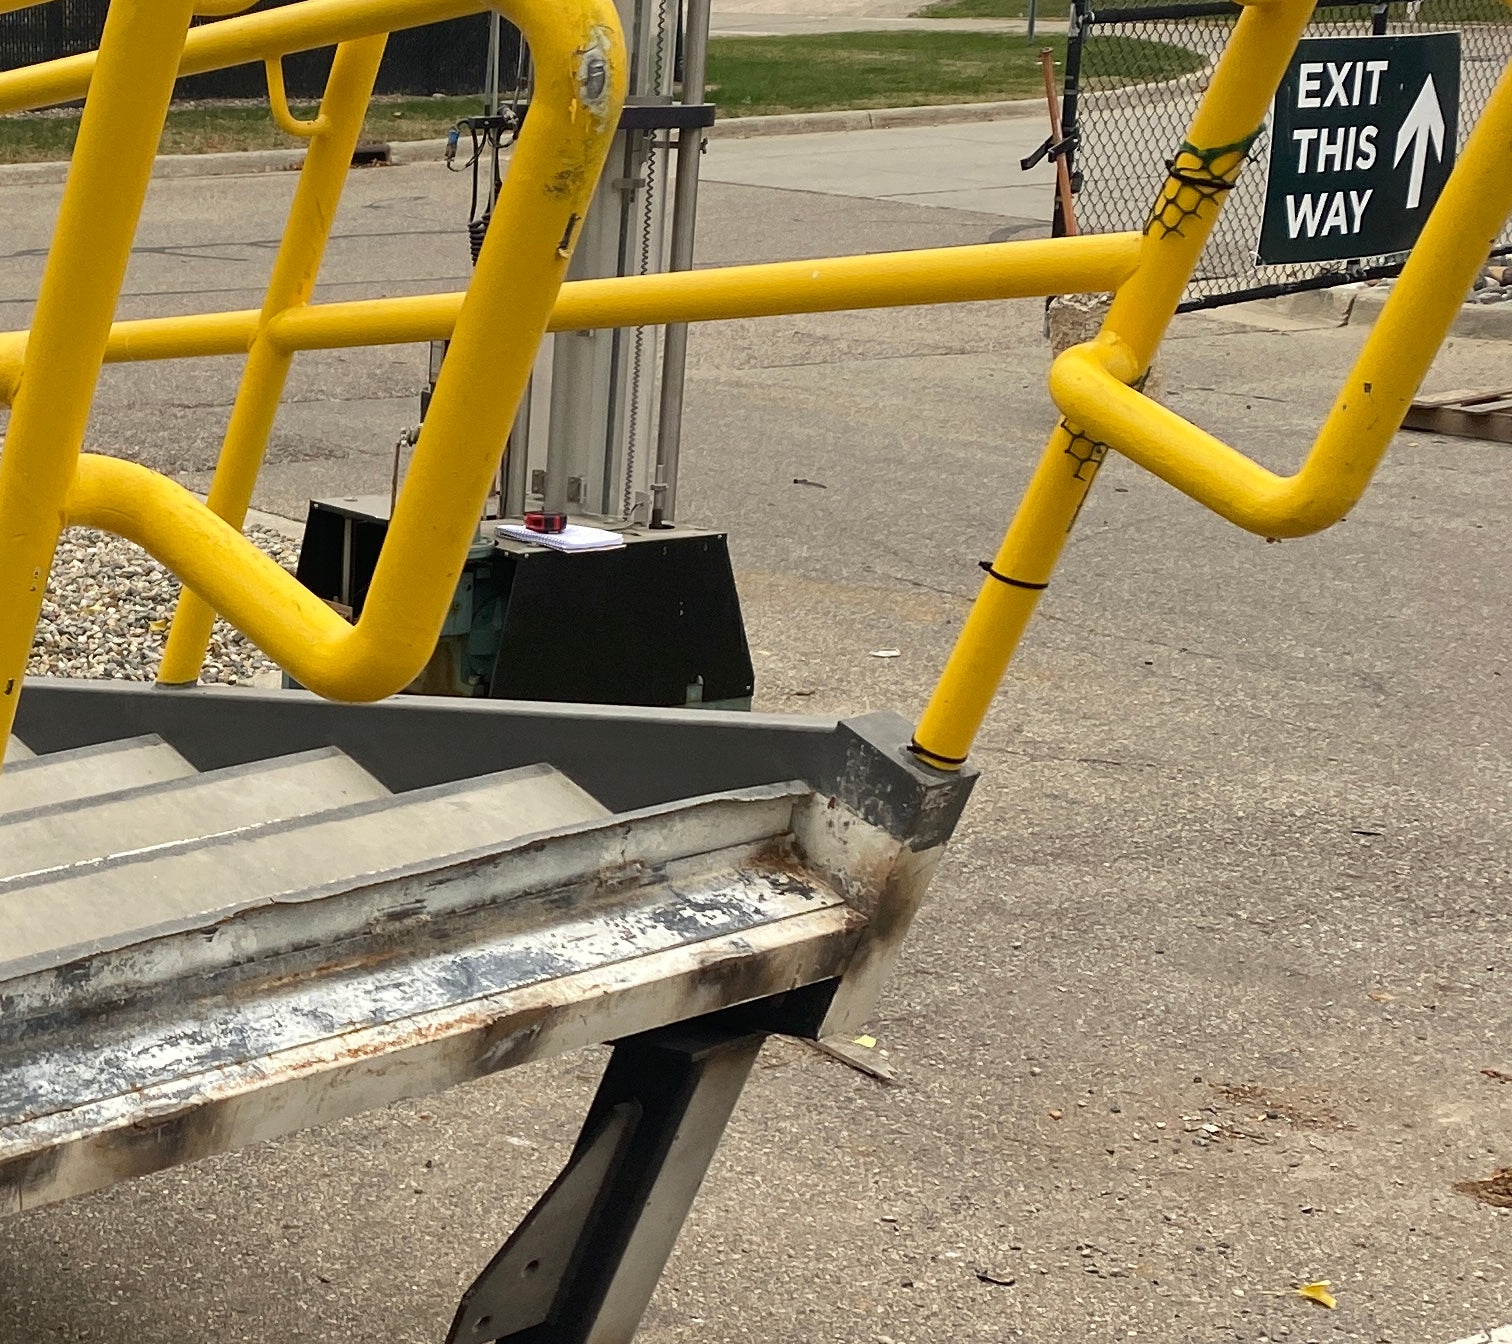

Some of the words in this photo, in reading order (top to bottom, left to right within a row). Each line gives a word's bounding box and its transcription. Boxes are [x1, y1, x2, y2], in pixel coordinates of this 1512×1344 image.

[1297, 60, 1389, 109] EXIT
[1292, 125, 1379, 174] THIS
[1286, 189, 1374, 239] WAY
